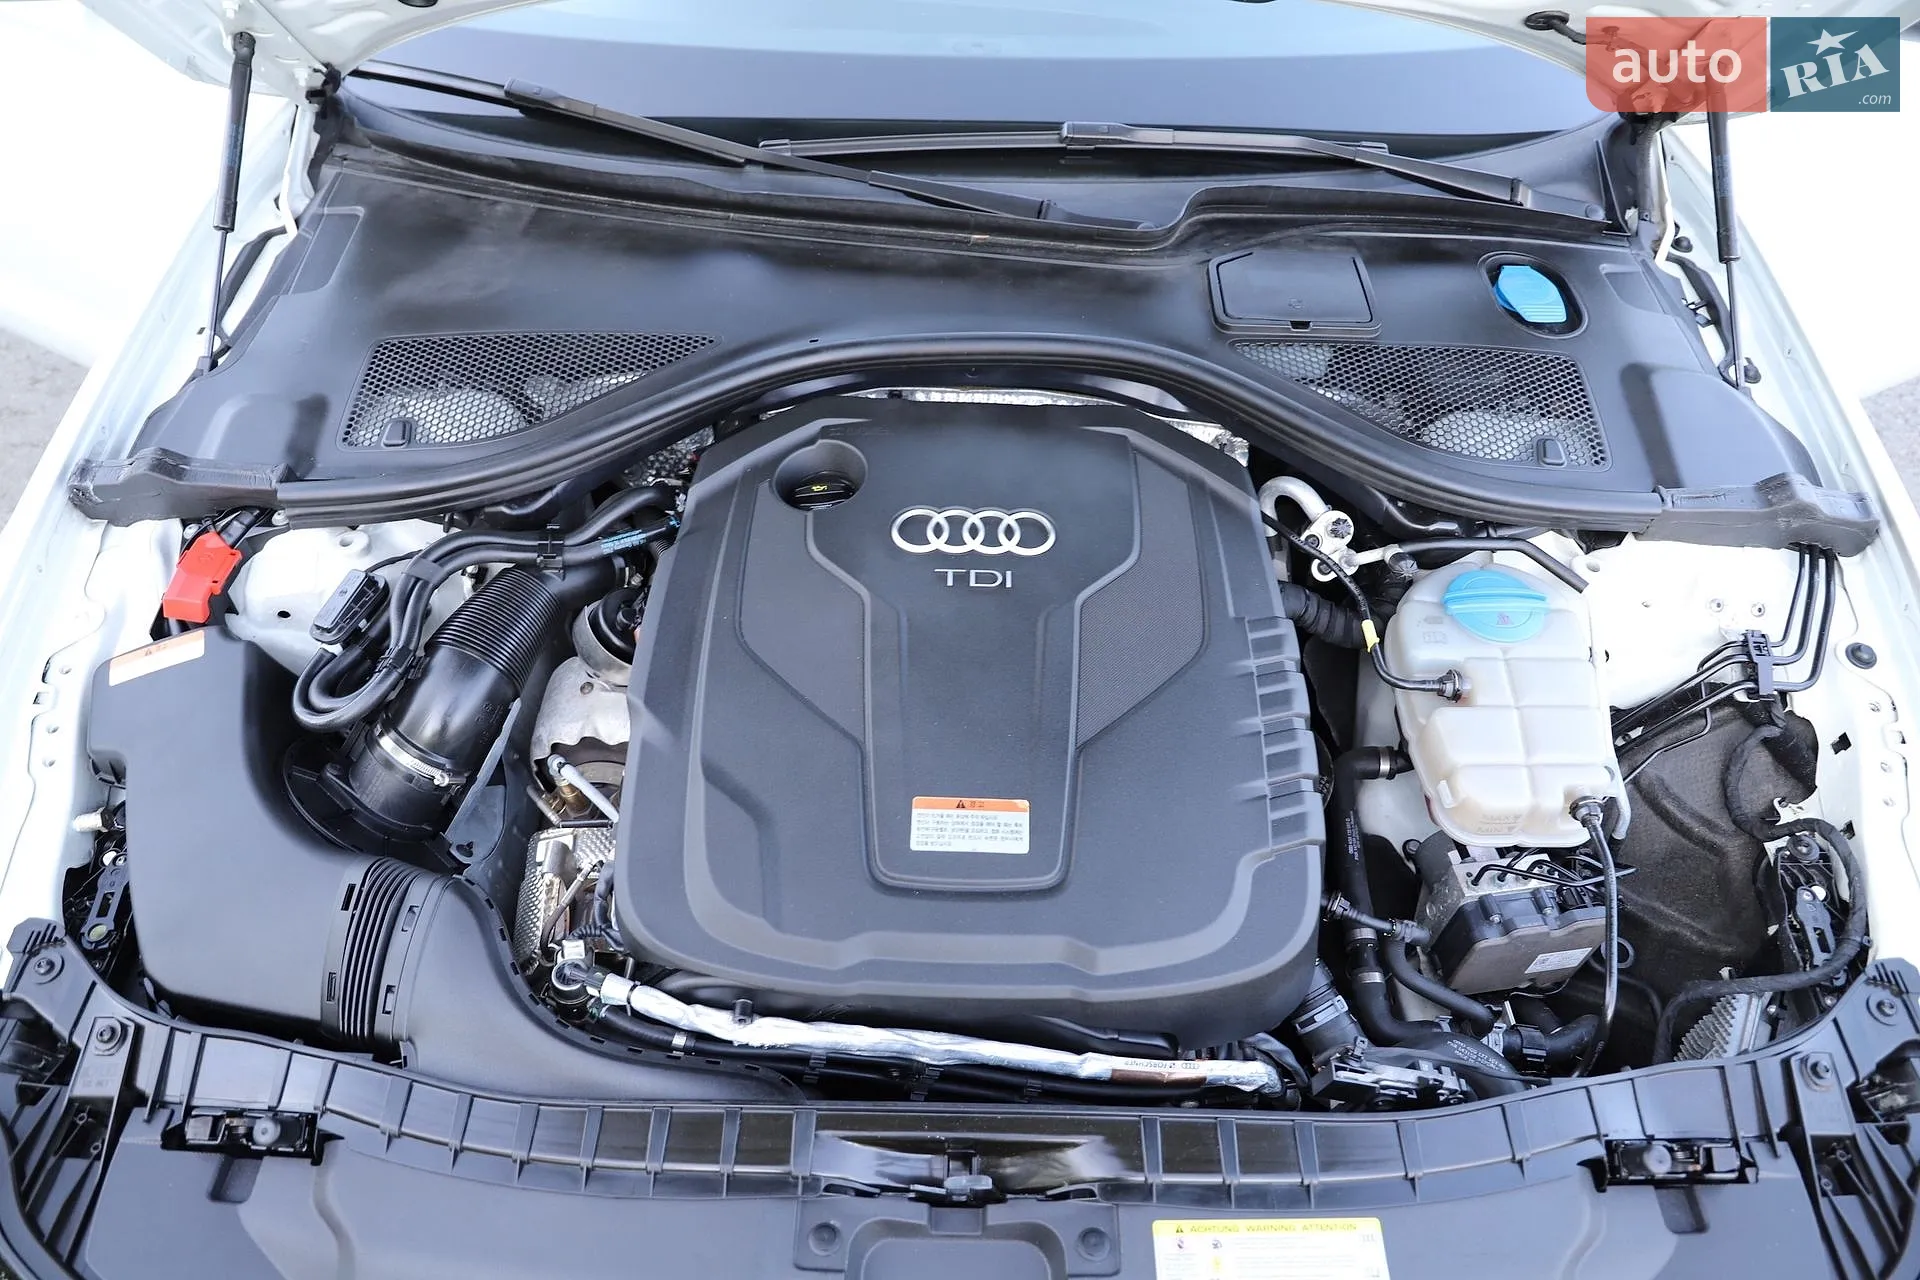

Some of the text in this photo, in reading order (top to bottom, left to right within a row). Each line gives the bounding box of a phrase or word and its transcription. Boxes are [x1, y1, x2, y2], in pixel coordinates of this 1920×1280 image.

[933, 568, 1012, 588] TDI
[1190, 1223, 1357, 1233] ACHTUNG WARNING ATTENTION
